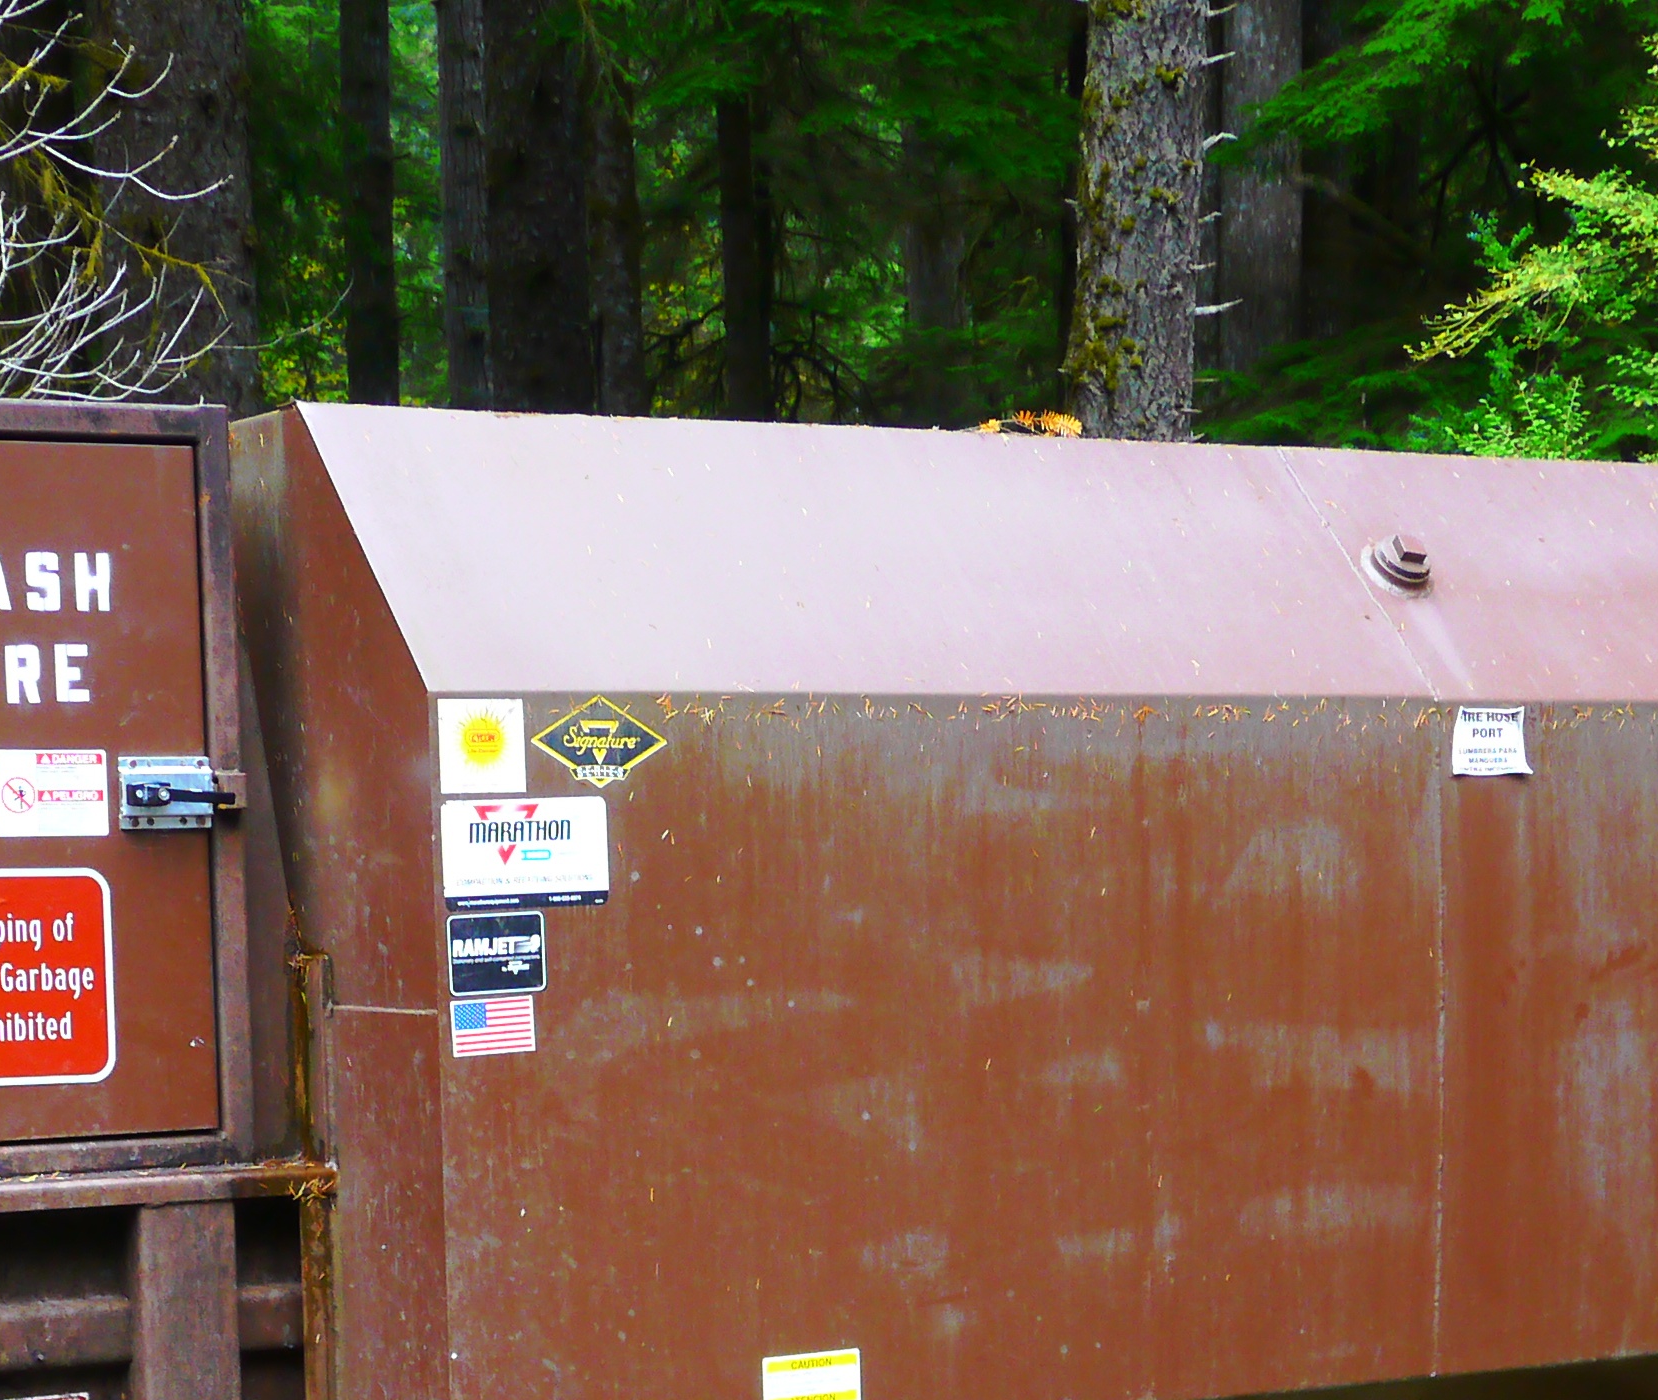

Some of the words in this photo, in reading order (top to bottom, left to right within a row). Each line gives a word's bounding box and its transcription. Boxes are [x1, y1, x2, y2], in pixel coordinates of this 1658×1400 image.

[1486, 711, 1519, 723] HOSE
[563, 725, 637, 756] Signature
[1472, 728, 1503, 738] PORT
[51, 754, 98, 764] DANGER
[52, 790, 99, 801] PELIGRO
[469, 819, 571, 843] MARATHON
[52, 911, 75, 942] of
[452, 936, 517, 957] RAMJET
[0, 961, 95, 1000] Garbage
[790, 1357, 833, 1370] CAUTION
